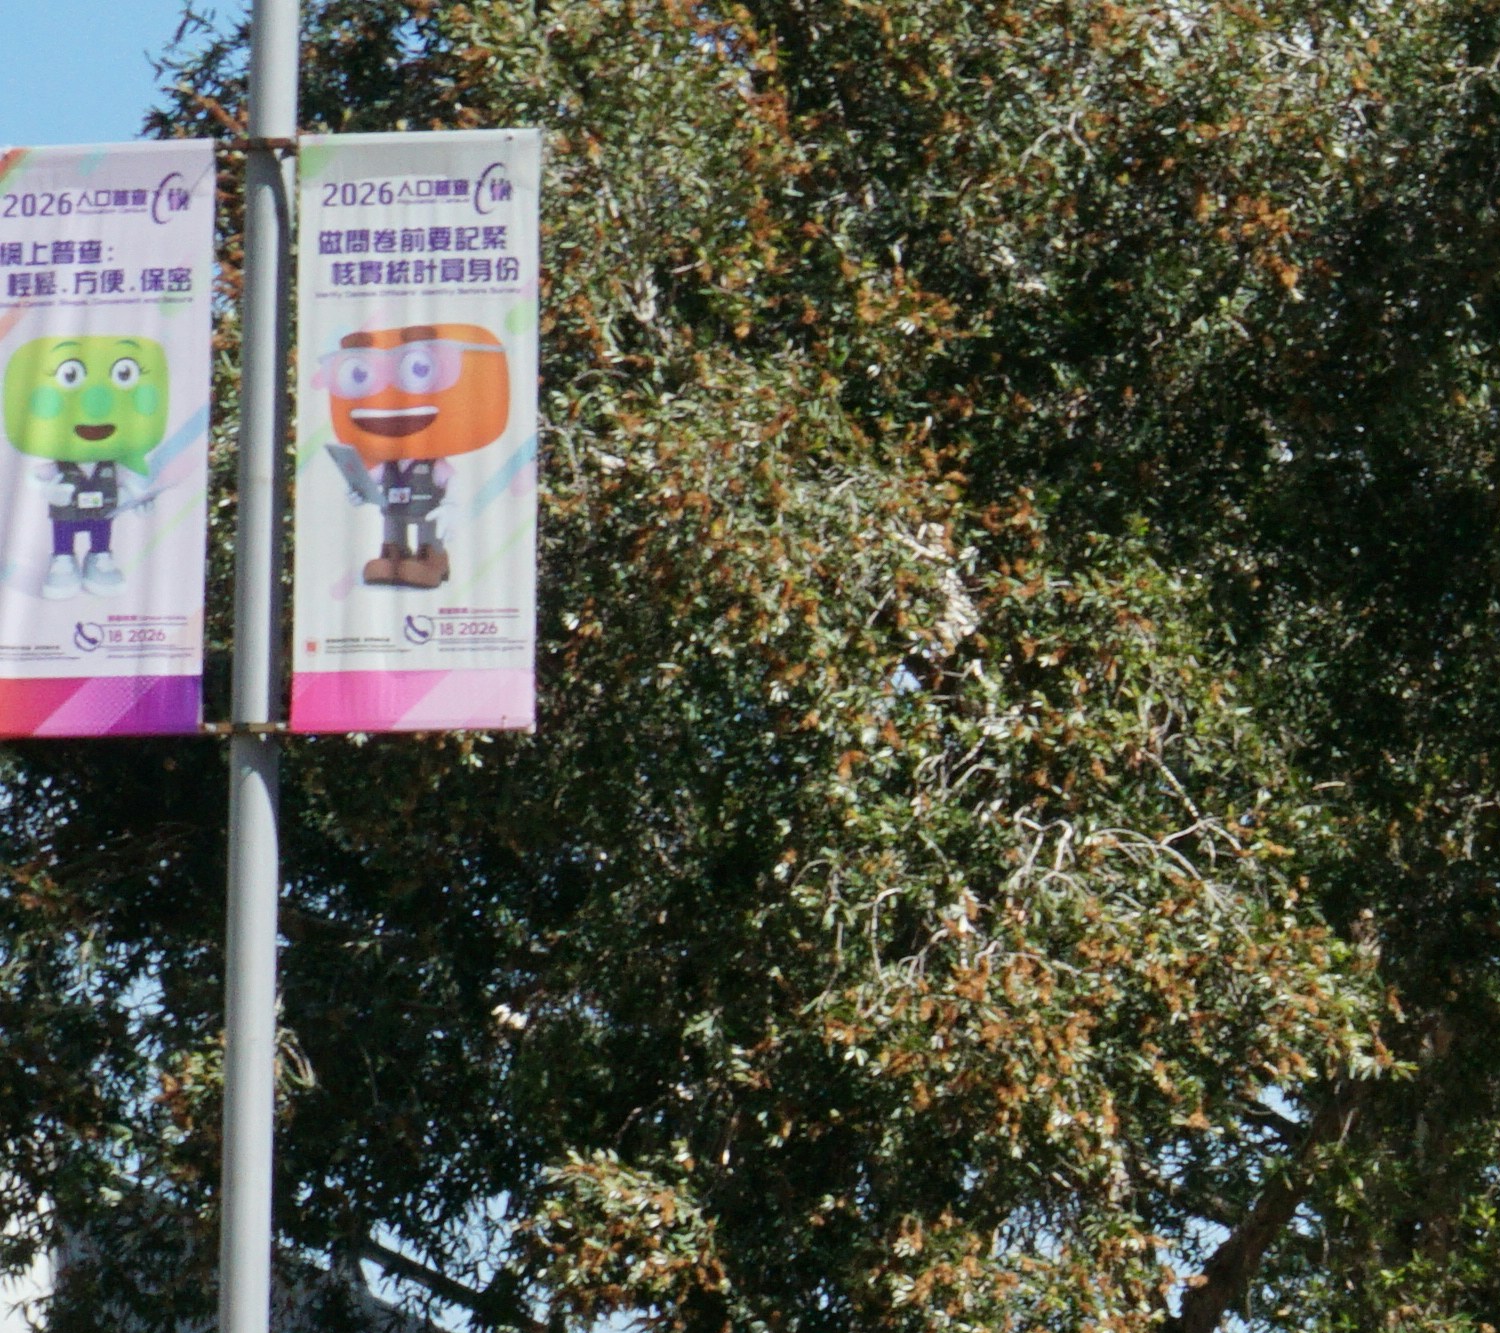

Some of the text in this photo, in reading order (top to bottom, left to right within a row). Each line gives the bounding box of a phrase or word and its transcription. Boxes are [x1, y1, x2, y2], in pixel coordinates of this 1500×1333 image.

[3, 189, 147, 218] 2026 人口普查
[322, 179, 470, 207] 2026 人口普查
[319, 225, 508, 255] 做問卷前要記緊
[331, 257, 520, 286] 核實統計員身份
[108, 629, 165, 643] 18 2026
[440, 621, 498, 636] 18 2026
